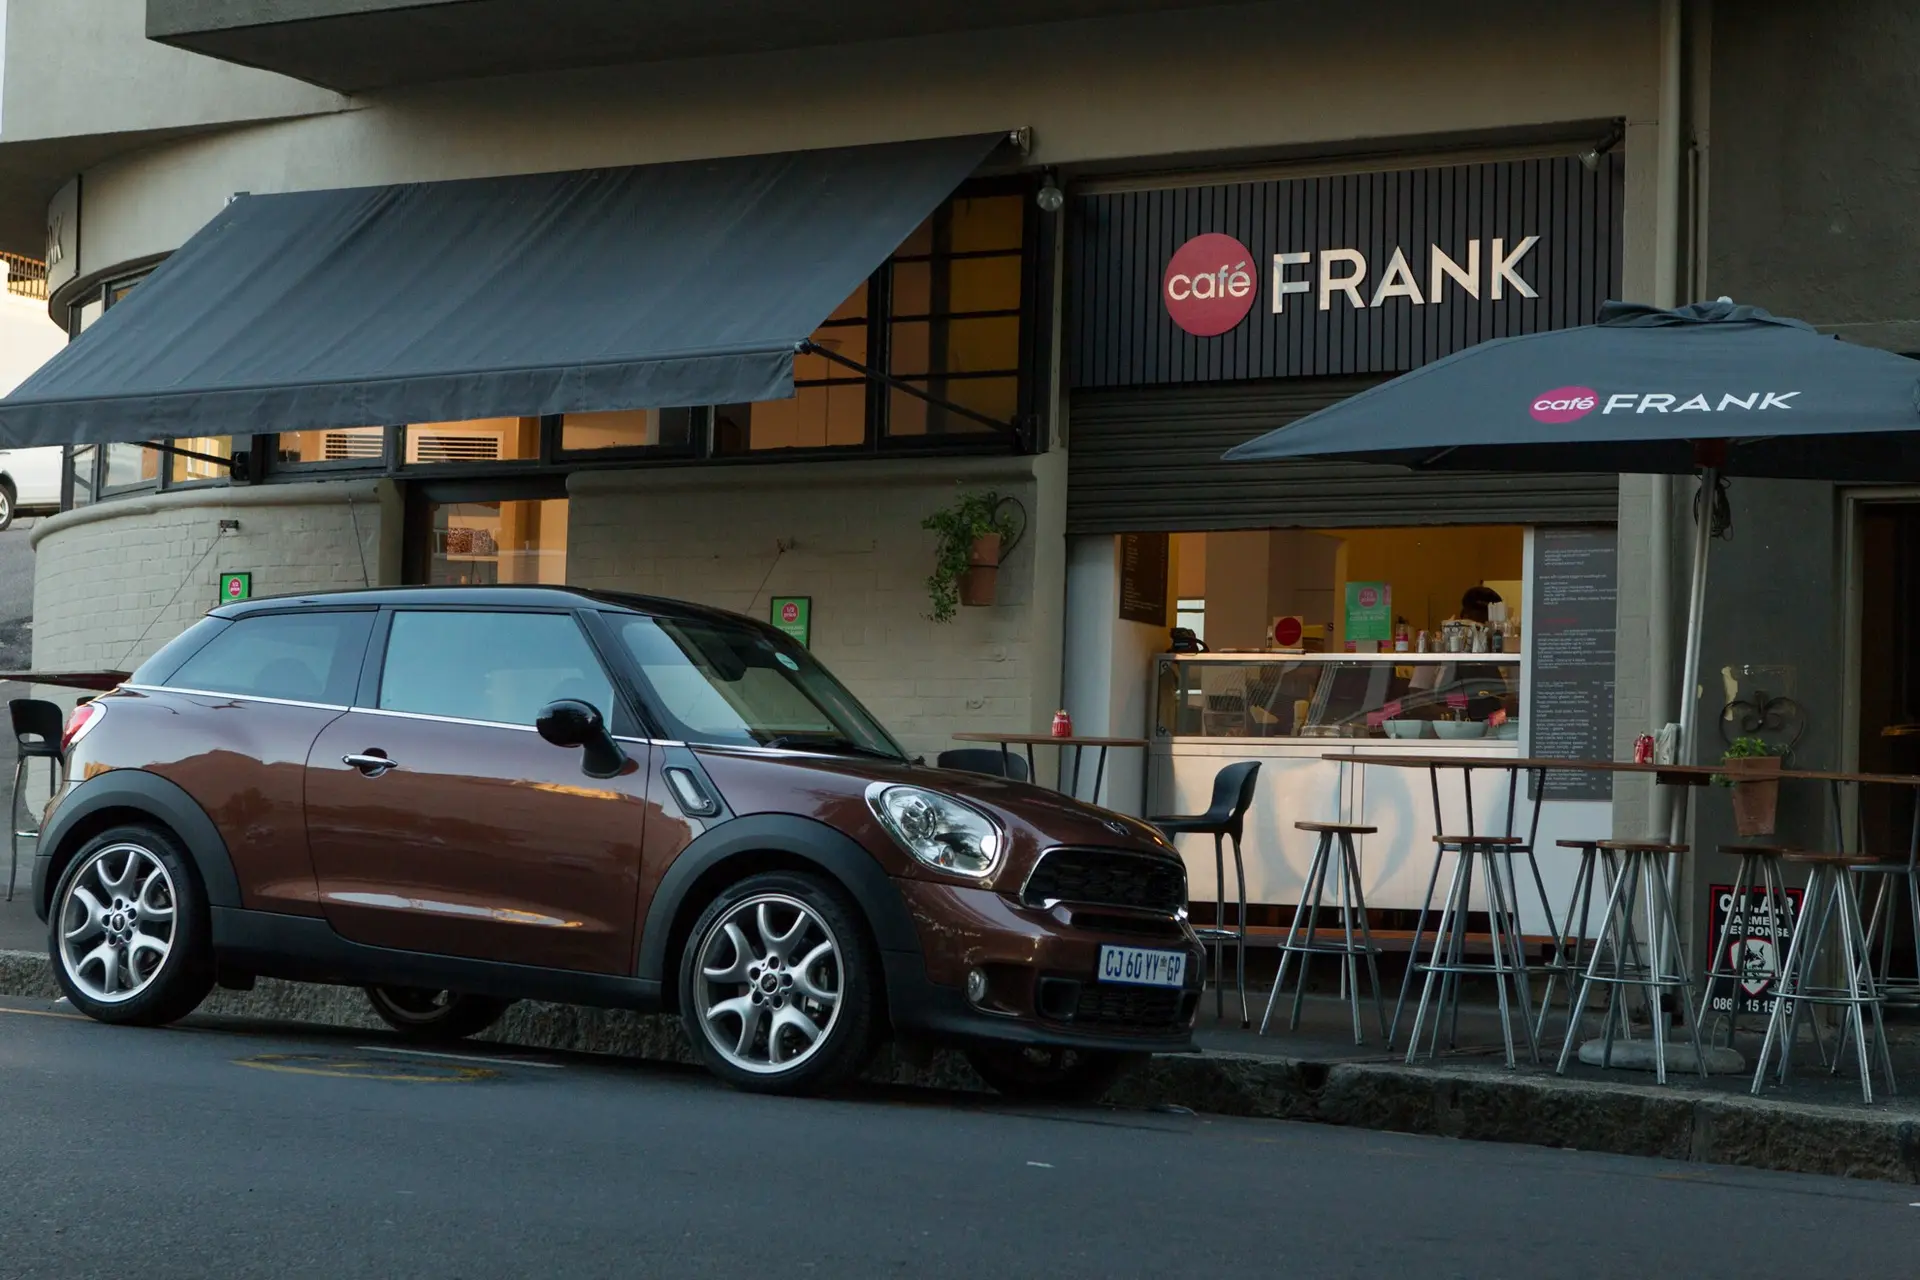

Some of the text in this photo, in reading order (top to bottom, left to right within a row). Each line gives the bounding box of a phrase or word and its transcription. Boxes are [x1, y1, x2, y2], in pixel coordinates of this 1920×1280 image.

[1168, 235, 1541, 314] café FRANK
[1533, 391, 1802, 415] café FRANK
[1106, 950, 1180, 982] CJ 60 YY GP
[1713, 997, 1740, 1010] 086
